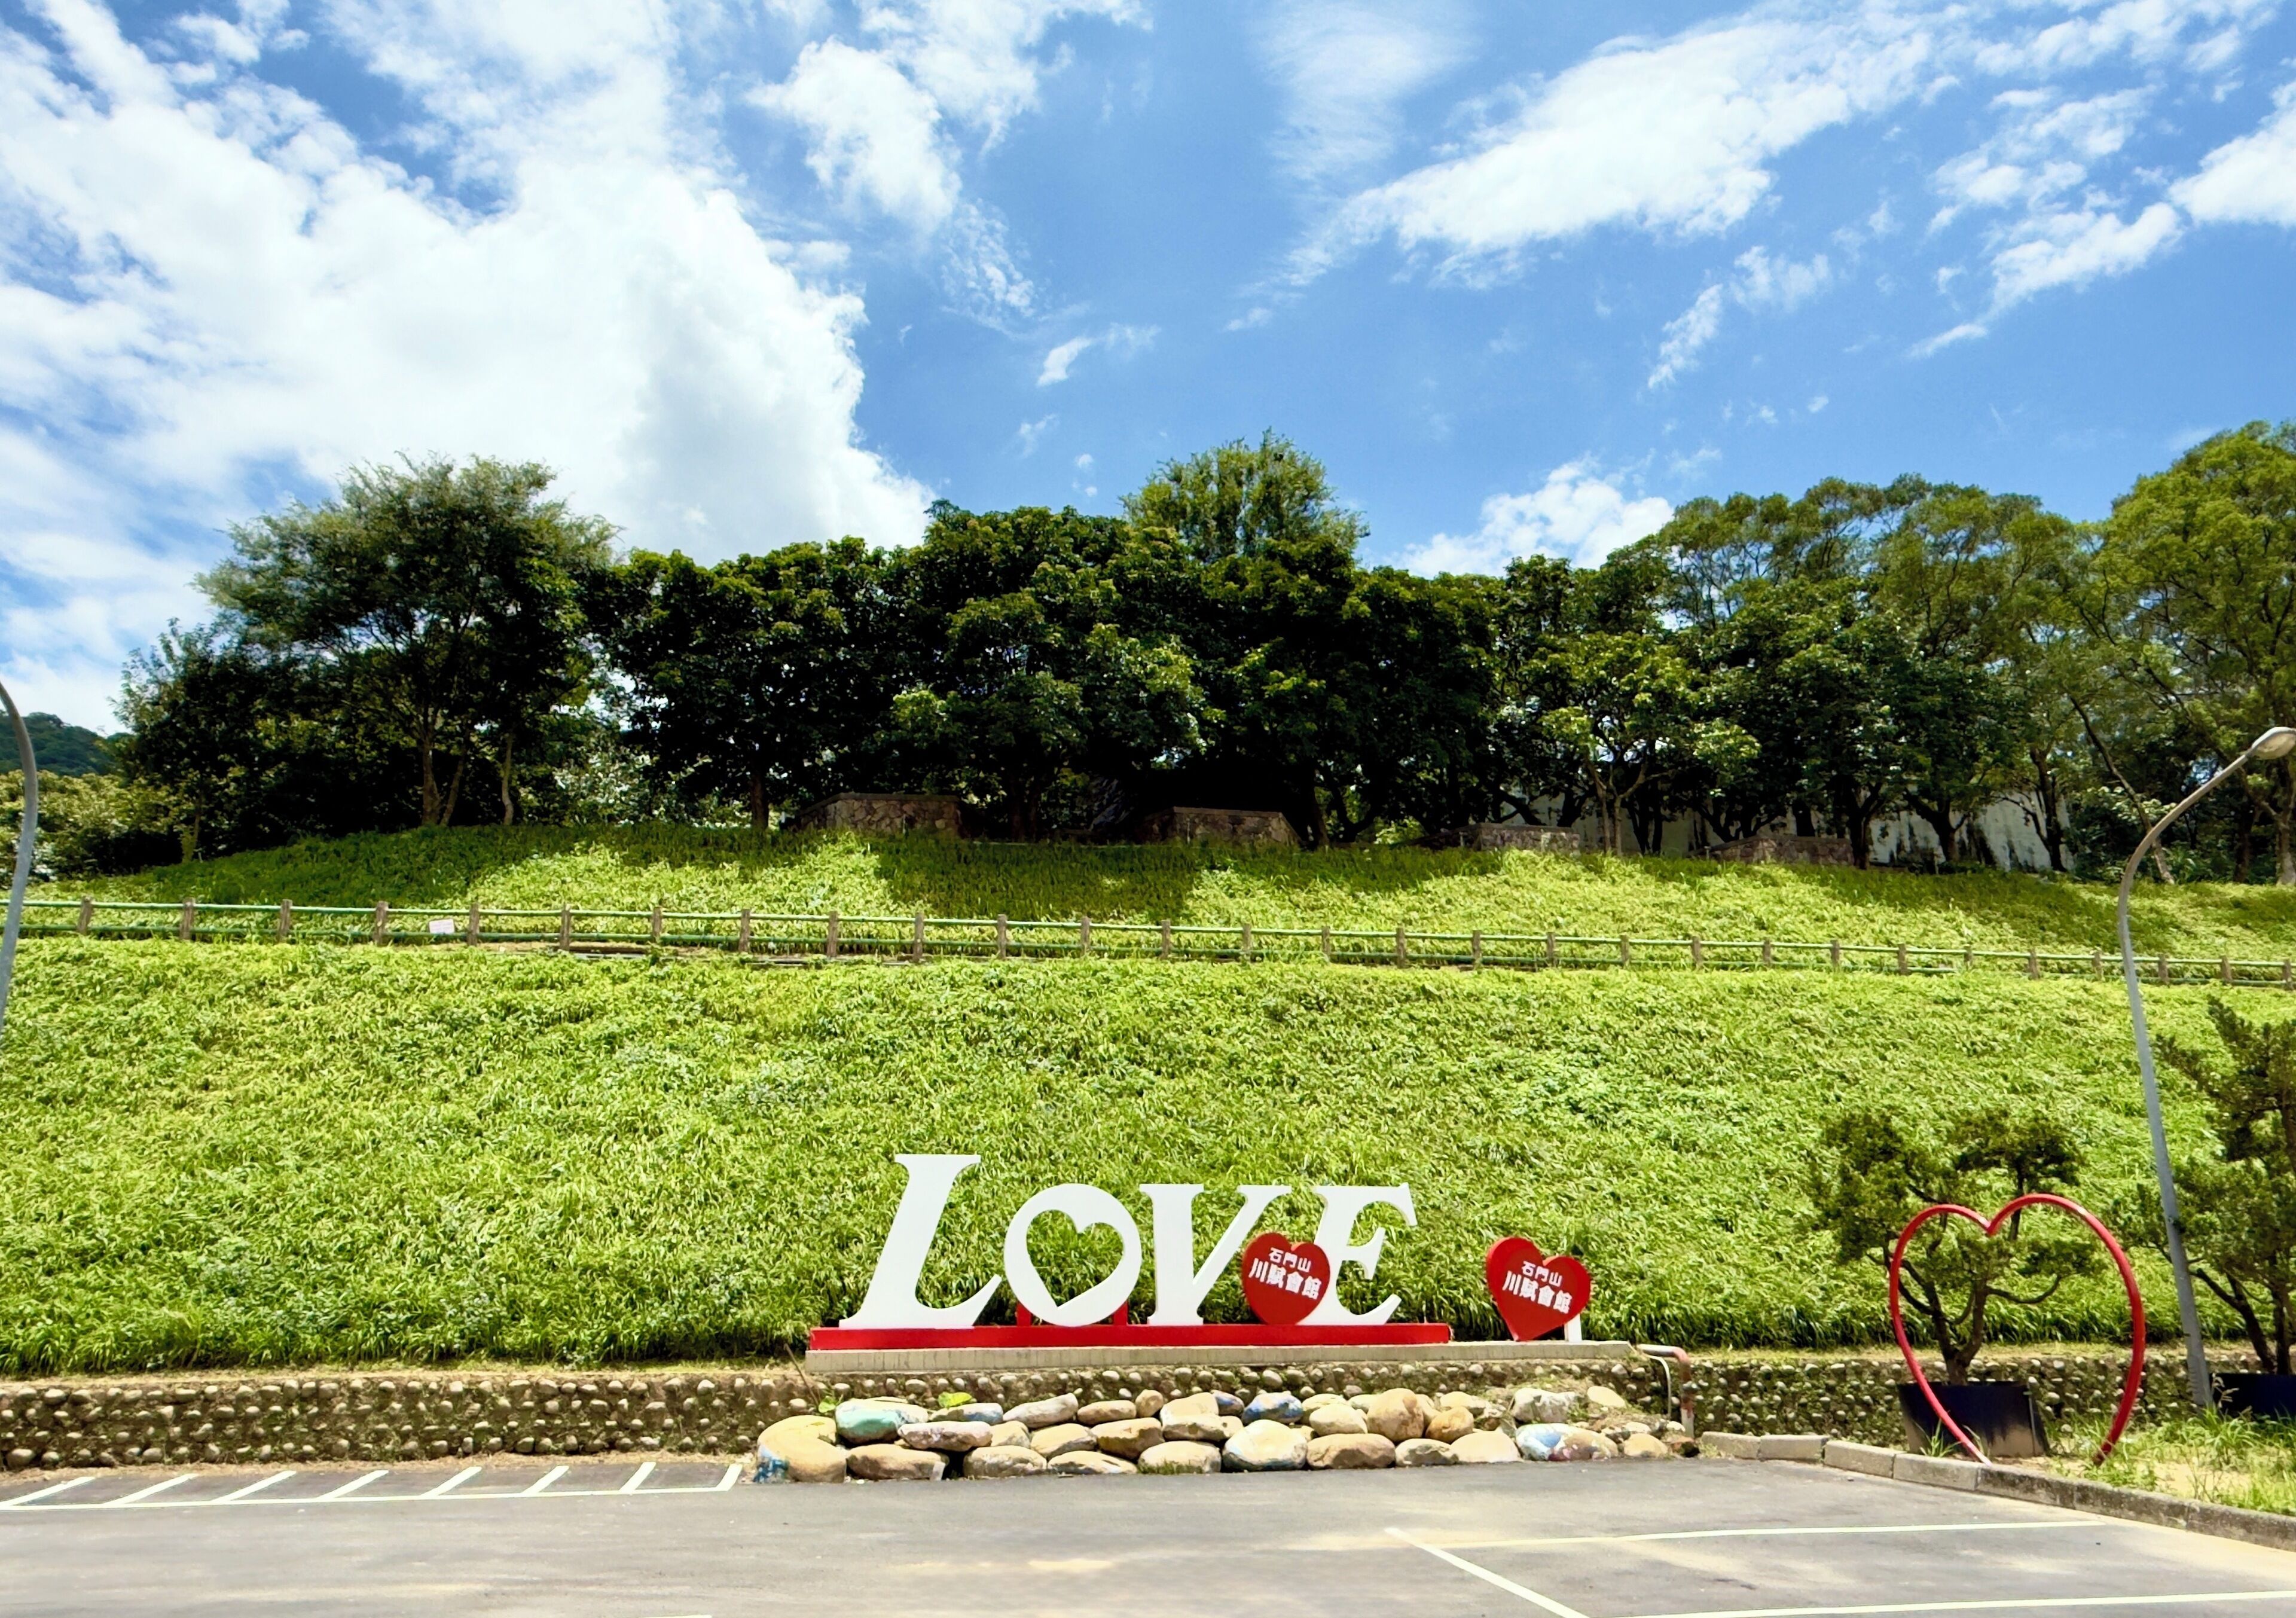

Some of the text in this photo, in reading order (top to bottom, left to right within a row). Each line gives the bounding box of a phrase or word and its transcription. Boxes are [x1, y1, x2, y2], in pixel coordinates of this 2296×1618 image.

[838, 1153, 1418, 1328] LOVE
[1269, 1247, 1311, 1272] 石門山
[1522, 1260, 1562, 1287] 石門山
